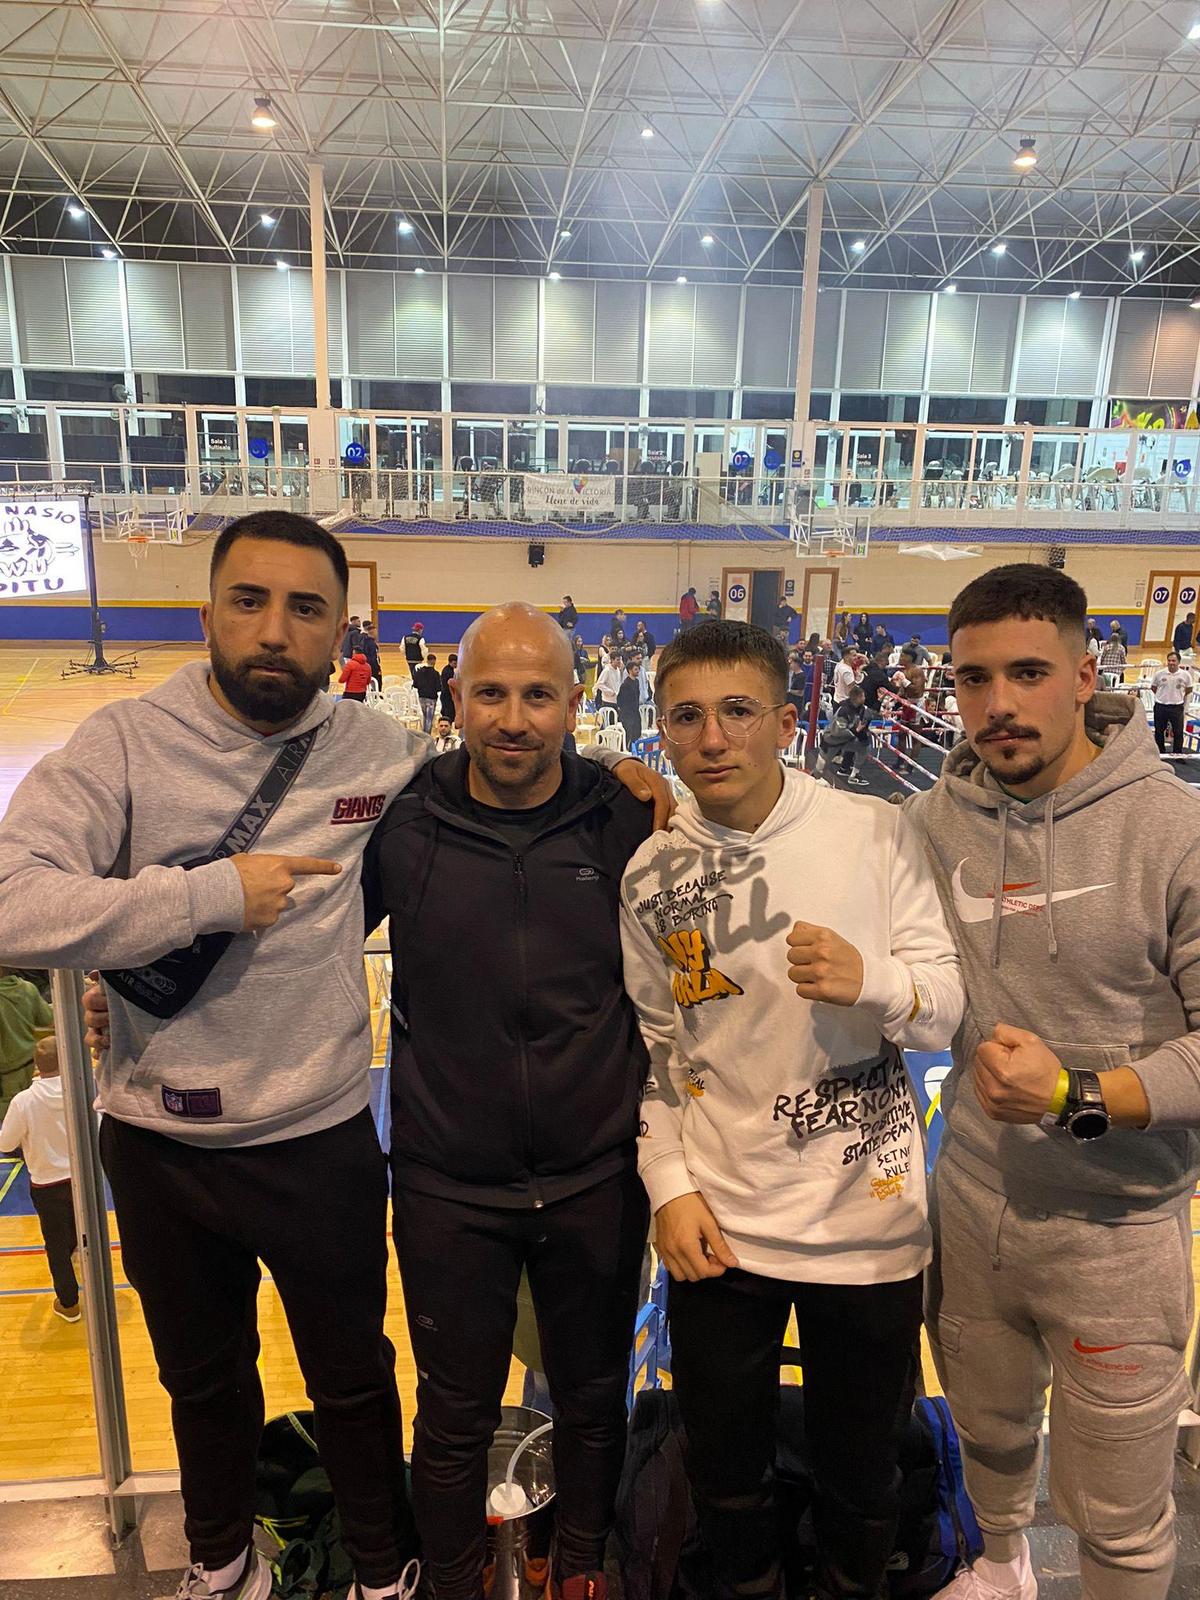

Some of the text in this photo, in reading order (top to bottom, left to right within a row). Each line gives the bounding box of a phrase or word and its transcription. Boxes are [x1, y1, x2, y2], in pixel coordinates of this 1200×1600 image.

[347, 447, 362, 458] 02
[730, 588, 745, 599] 06
[1154, 590, 1168, 601] 07
[1181, 590, 1195, 601] 07
[332, 794, 386, 819] GIANTS
[225, 794, 274, 852] MAX
[637, 870, 728, 914] JUST BECAUSE
[655, 890, 707, 919] NORMAL
[773, 1057, 889, 1121] RESPECT
[791, 1100, 861, 1139] FEAR
[842, 1137, 881, 1165] STATE
[876, 1149, 898, 1168] SET
